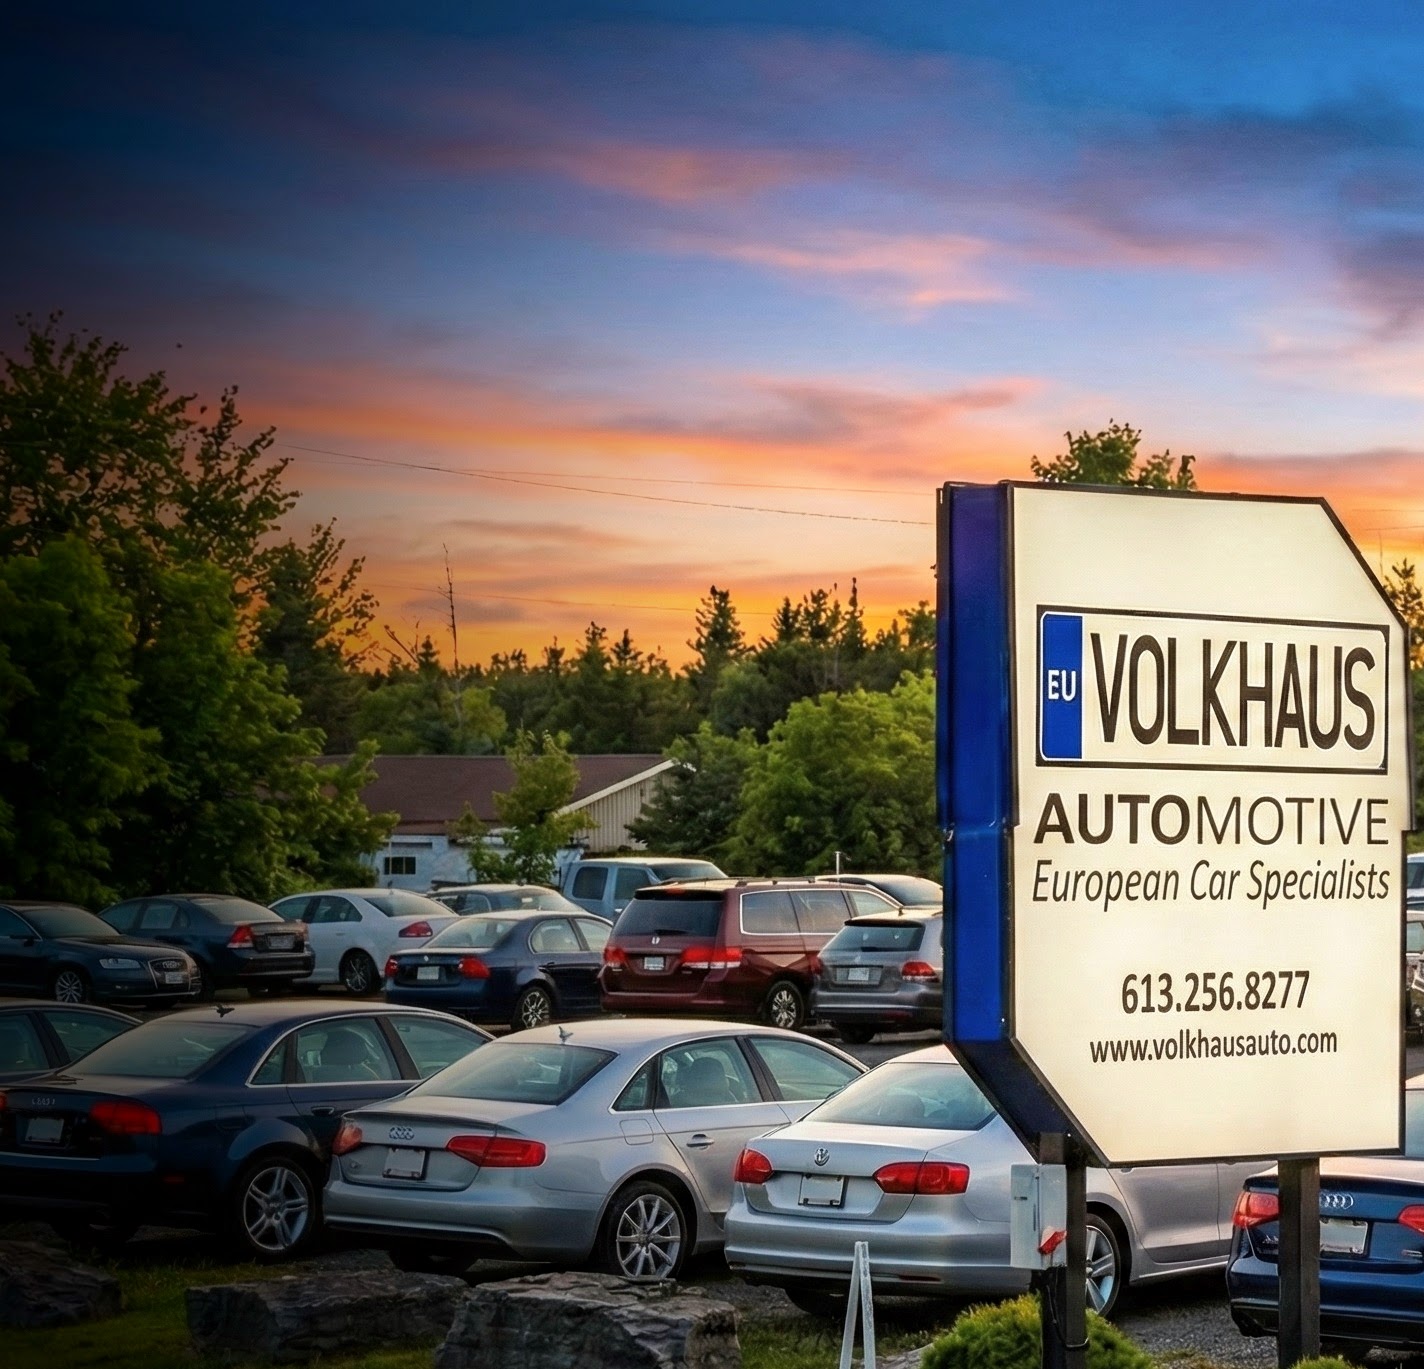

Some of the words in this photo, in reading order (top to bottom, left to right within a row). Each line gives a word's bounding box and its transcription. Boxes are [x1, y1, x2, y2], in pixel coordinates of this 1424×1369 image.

[1048, 669, 1077, 702] EU
[1090, 632, 1376, 751] VOLKHAUS
[1034, 792, 1389, 846] AUTOMOTIVE
[1032, 859, 1179, 912] European
[1190, 860, 1240, 901] Car
[1246, 859, 1390, 909] Specialists
[1121, 970, 1310, 1015] 613.256.8277
[1090, 1028, 1338, 1064] www.volkhausauto.com
